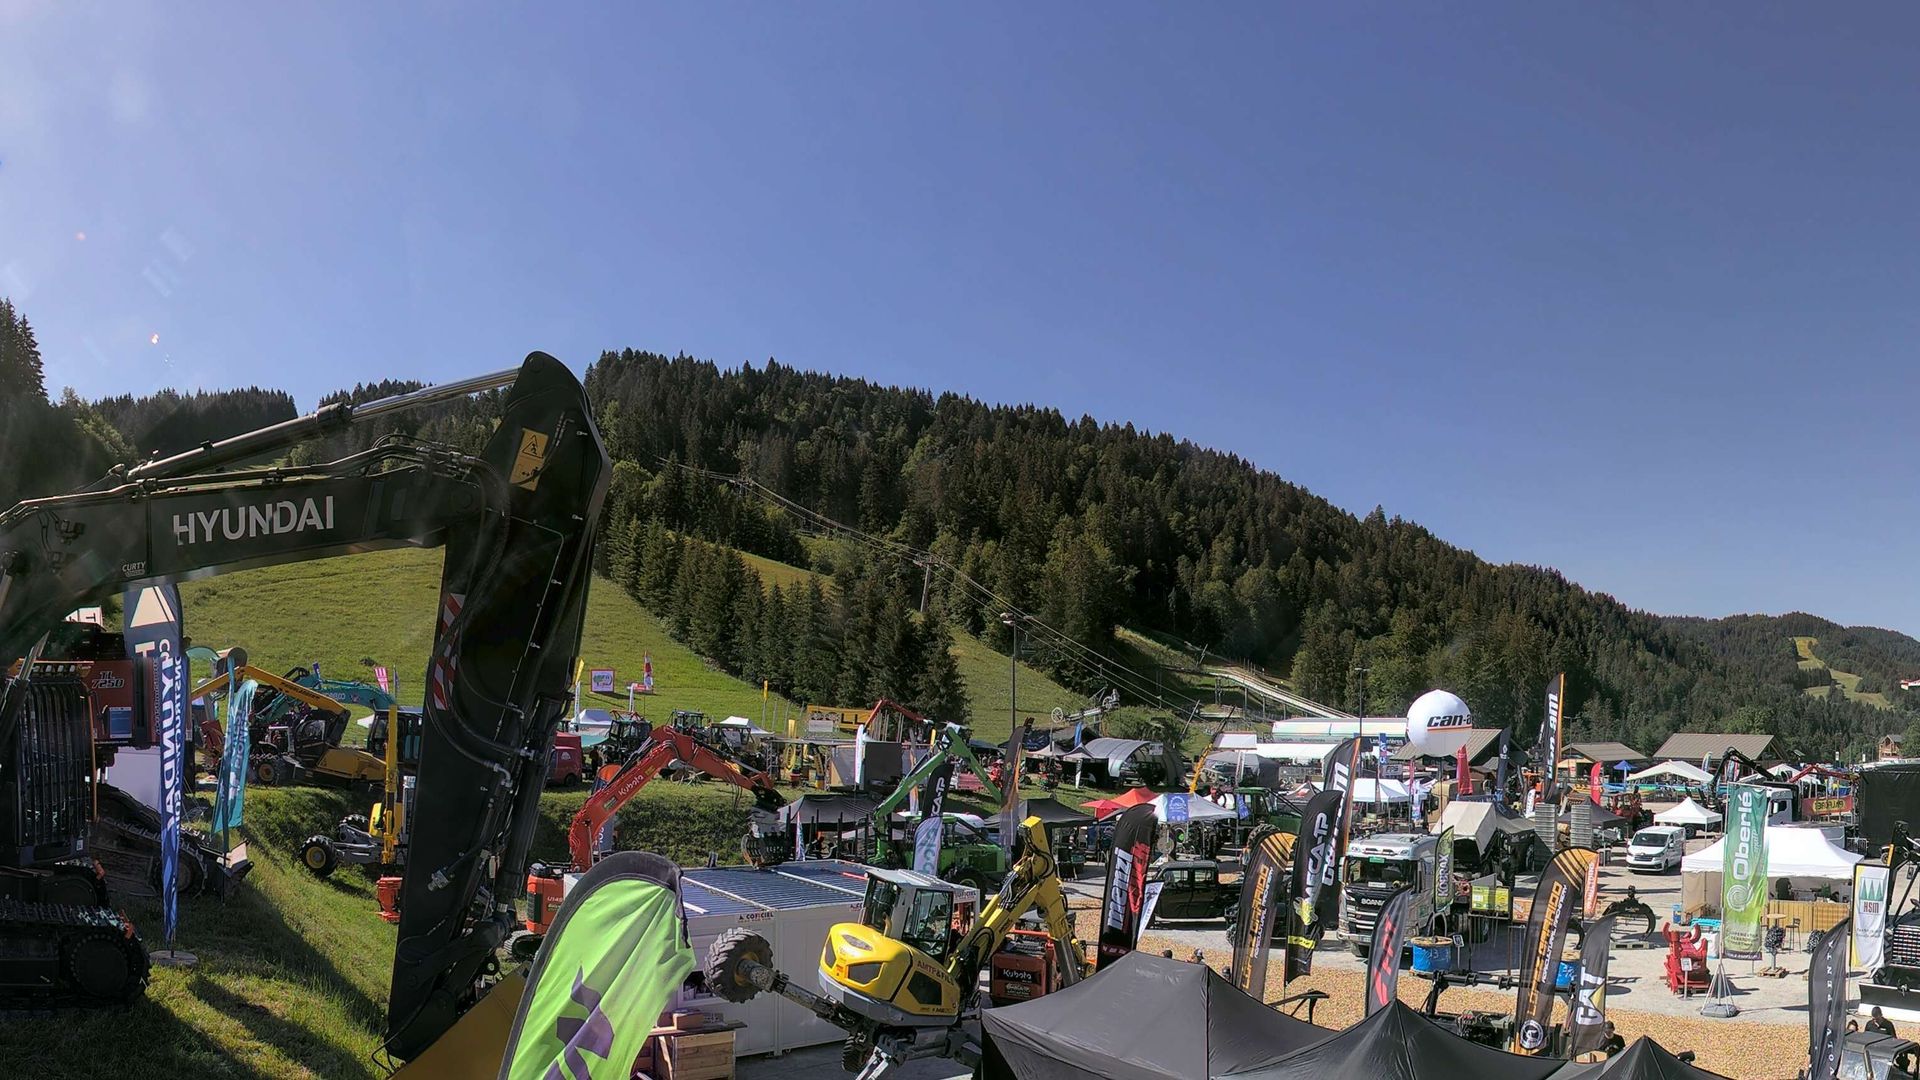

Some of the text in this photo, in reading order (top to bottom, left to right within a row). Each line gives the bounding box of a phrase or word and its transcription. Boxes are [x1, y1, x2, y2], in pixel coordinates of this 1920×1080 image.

[173, 496, 334, 545] HYUNDAI
[122, 562, 146, 572] CURTY
[618, 775, 644, 796] Kubota
[1733, 791, 1753, 880] Oberlé
[1107, 847, 1133, 931] menzi
[1438, 853, 1449, 897] KOBRAX
[1003, 969, 1032, 980] Kubota
[1576, 966, 1603, 1024] CAT
[1826, 941, 1835, 1001] PENTA
